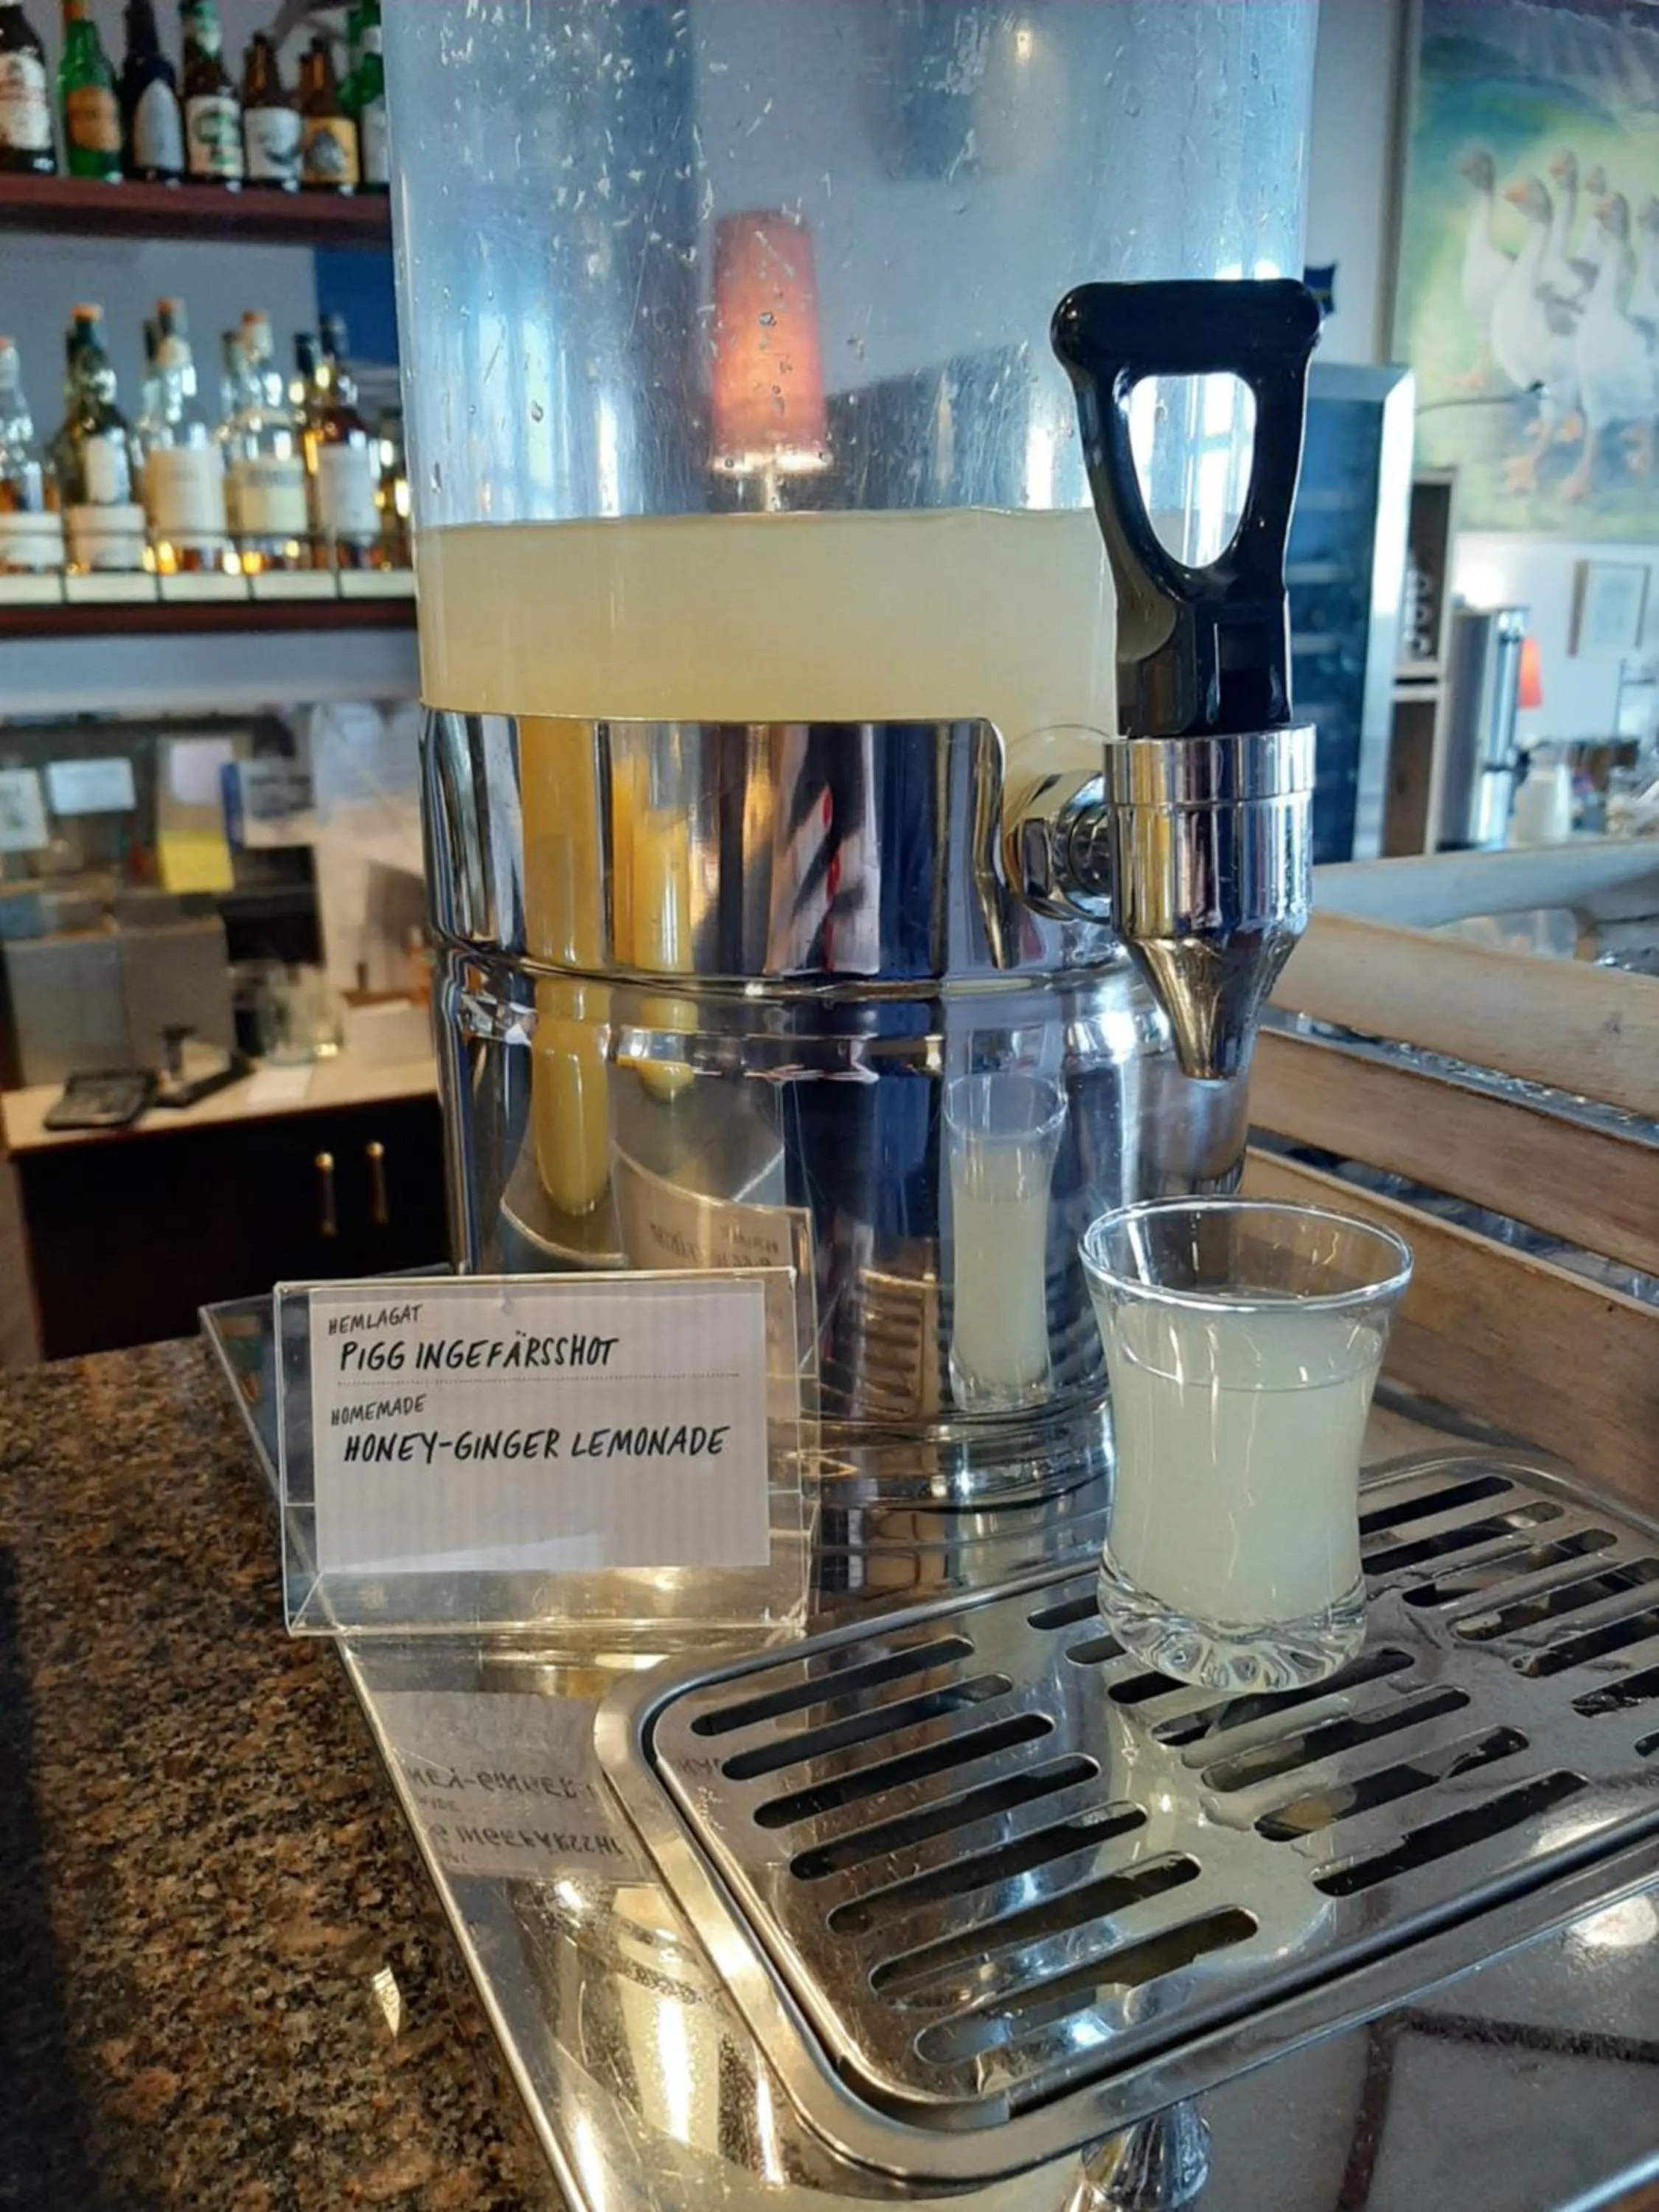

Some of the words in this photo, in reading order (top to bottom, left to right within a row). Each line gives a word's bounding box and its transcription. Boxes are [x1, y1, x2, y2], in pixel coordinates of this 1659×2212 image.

[328, 1304, 422, 1335] HEMLAGAT
[340, 1341, 405, 1371] PIGG
[415, 1330, 619, 1370] INGEFÄRSSHOT
[330, 1394, 427, 1426] HOMEMADE
[344, 1428, 560, 1464] HONEY-GINGER
[571, 1425, 731, 1457] LEMONADE
